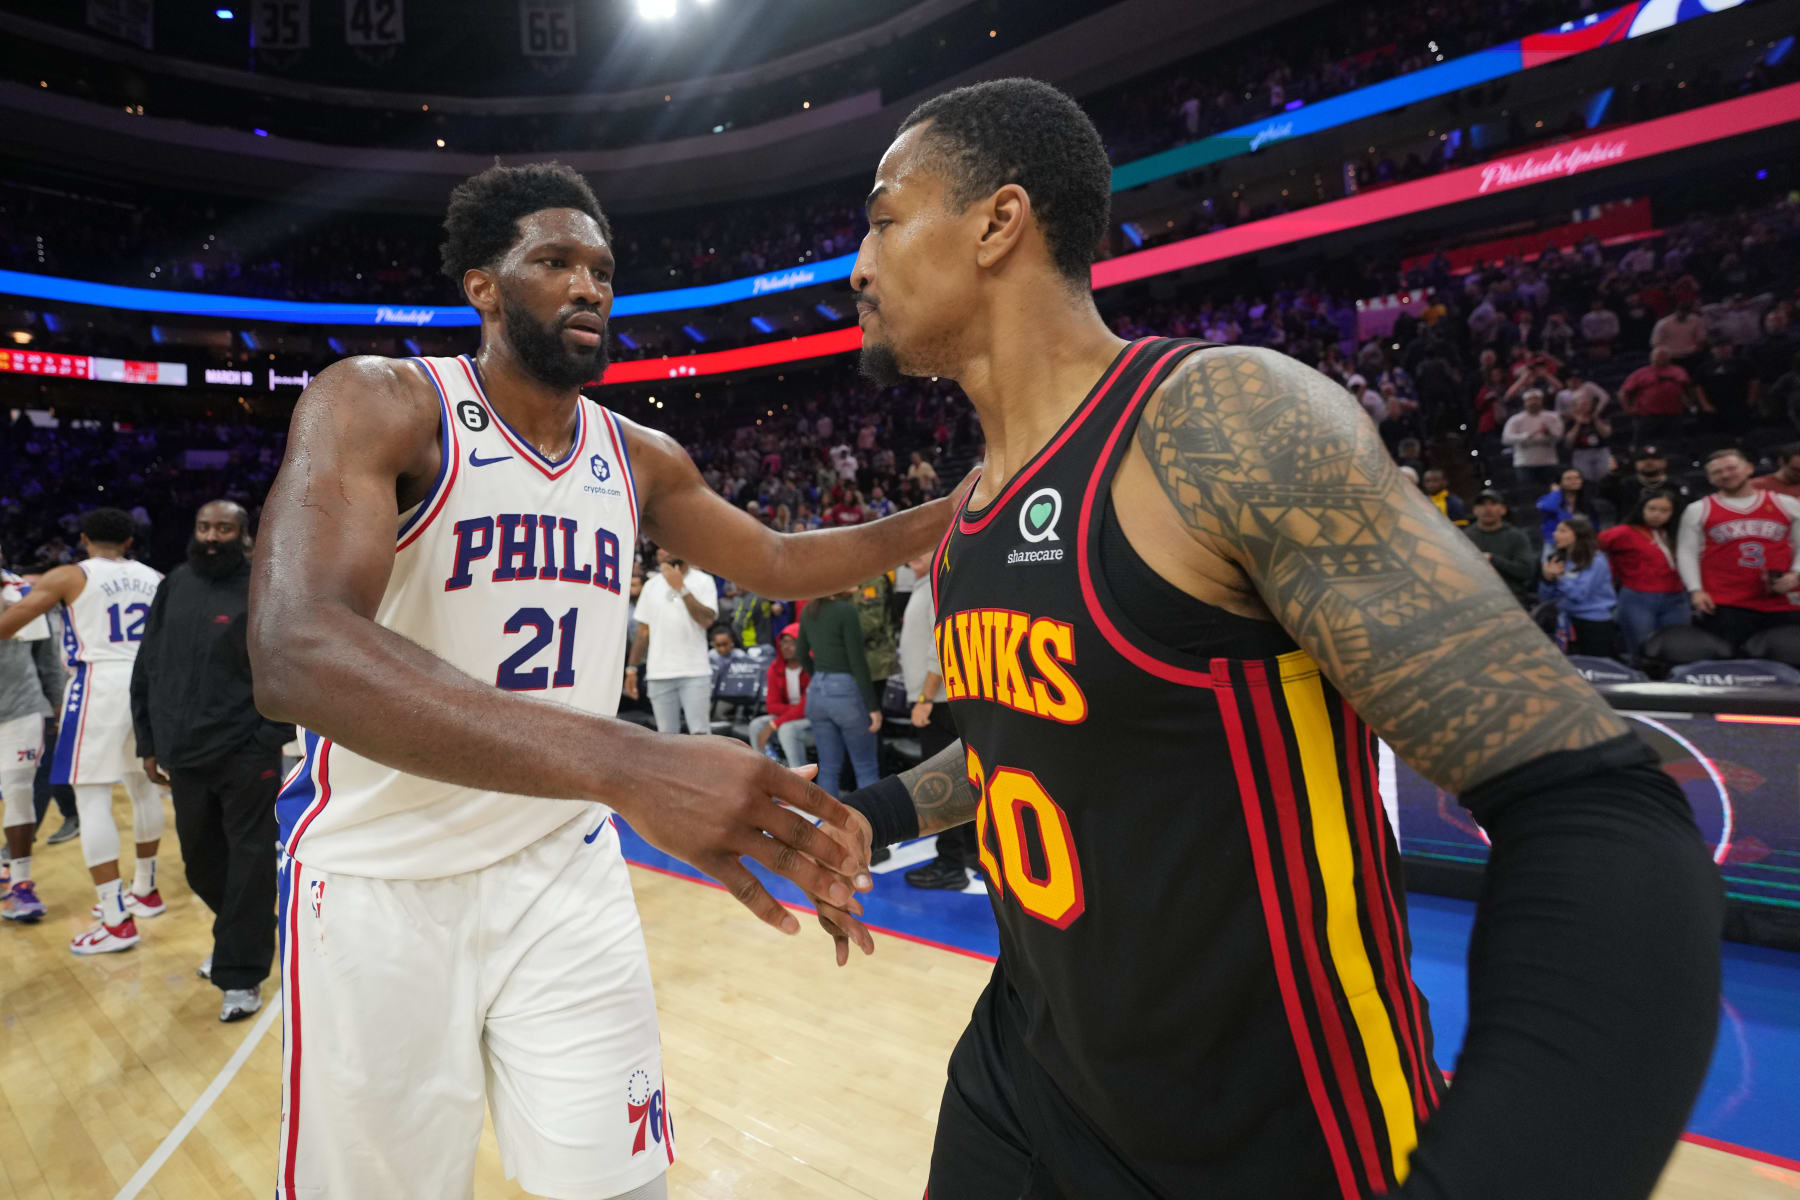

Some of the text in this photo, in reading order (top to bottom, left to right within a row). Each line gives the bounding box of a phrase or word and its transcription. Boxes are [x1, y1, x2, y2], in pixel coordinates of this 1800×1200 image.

[351, 0, 396, 41] 42
[529, 12, 568, 52] 66
[1479, 141, 1626, 193] Philadelphia
[463, 405, 482, 428] 6
[583, 485, 621, 496] crypto.com
[1709, 518, 1786, 544] SIXERS
[445, 513, 621, 595] PHILA
[1007, 548, 1064, 564] sharecare
[1738, 541, 1765, 568] 3
[100, 577, 157, 597] HARRIS
[107, 602, 151, 643] 12
[496, 607, 578, 691] 21
[966, 742, 1085, 931] 20
